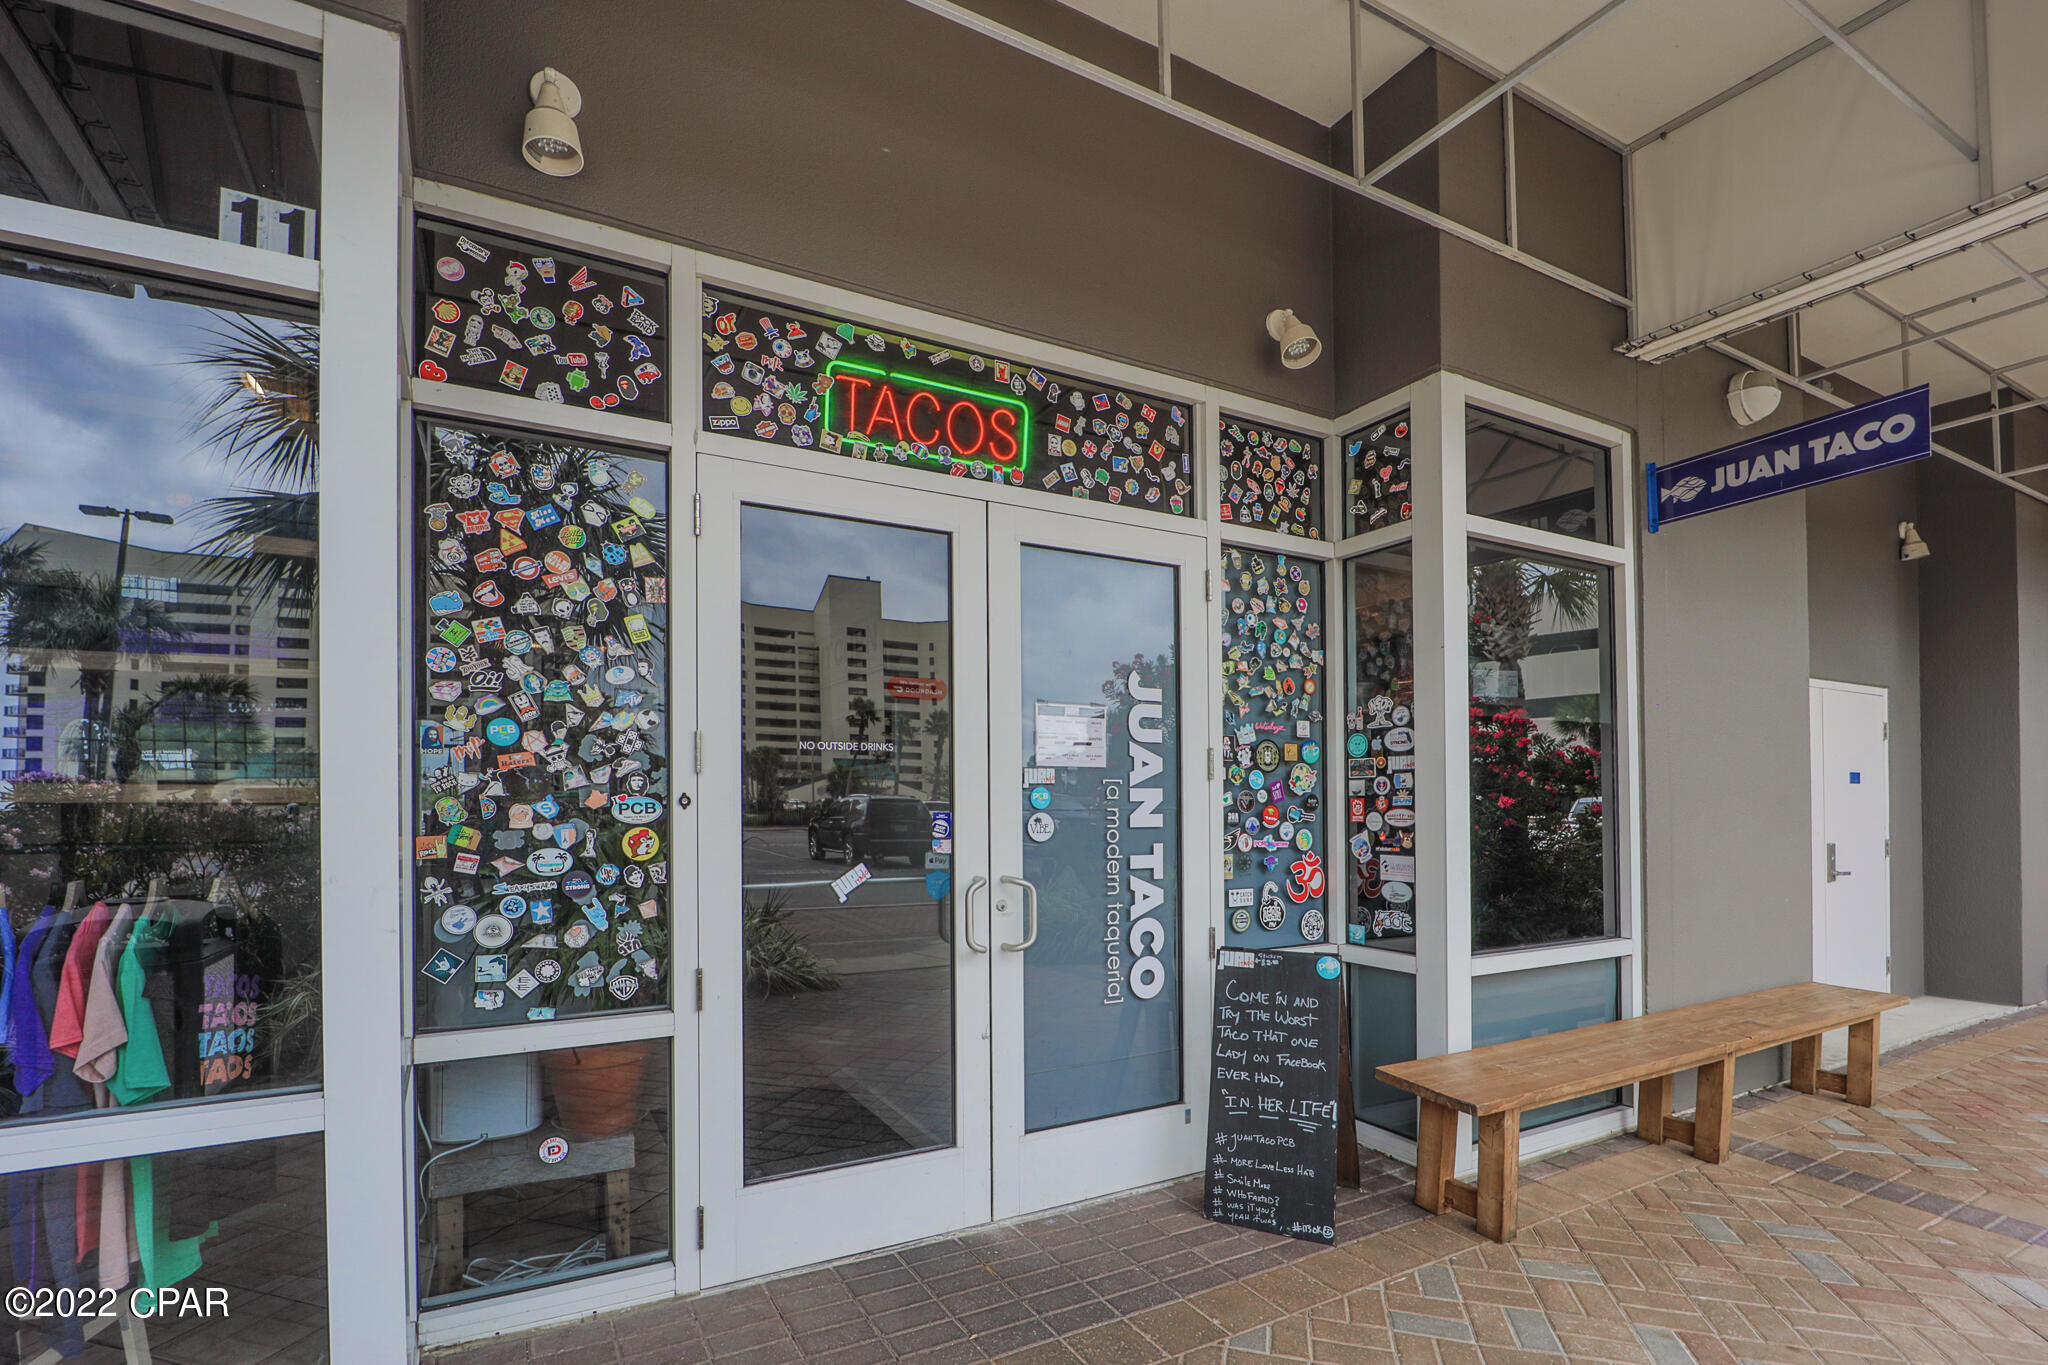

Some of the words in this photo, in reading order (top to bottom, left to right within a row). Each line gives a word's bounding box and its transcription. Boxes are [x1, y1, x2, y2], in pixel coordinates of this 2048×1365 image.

[835, 374, 1018, 462] TACOS
[1711, 445, 1800, 493] JUAN
[1808, 413, 1916, 465] TACO
[490, 725, 517, 735] PCB
[800, 741, 815, 750] NO
[818, 741, 859, 751] OUTSIDE
[861, 742, 894, 751] DRINKS
[1127, 669, 1164, 828] JUAN
[1032, 792, 1049, 801] PCB
[618, 802, 657, 815] PCB
[1030, 823, 1051, 835] VIBE
[935, 856, 946, 865] Pay
[1106, 807, 1123, 896] modern
[1129, 843, 1165, 999] TACO
[1103, 904, 1123, 1005] taqueria]
[1226, 980, 1270, 1005] COME
[1276, 992, 1287, 1006] IN
[1293, 998, 1319, 1009] AND
[1219, 1006, 1240, 1025] TRY
[1245, 1010, 1270, 1022] THE
[1275, 1011, 1319, 1027] WORST
[1217, 1025, 1249, 1041] TACO
[1252, 1030, 1288, 1043] THAT
[1291, 1038, 1319, 1048] ONE
[1216, 1044, 1246, 1065] LADY
[1253, 1055, 1270, 1063] ON
[1217, 1067, 1251, 1081] EVER
